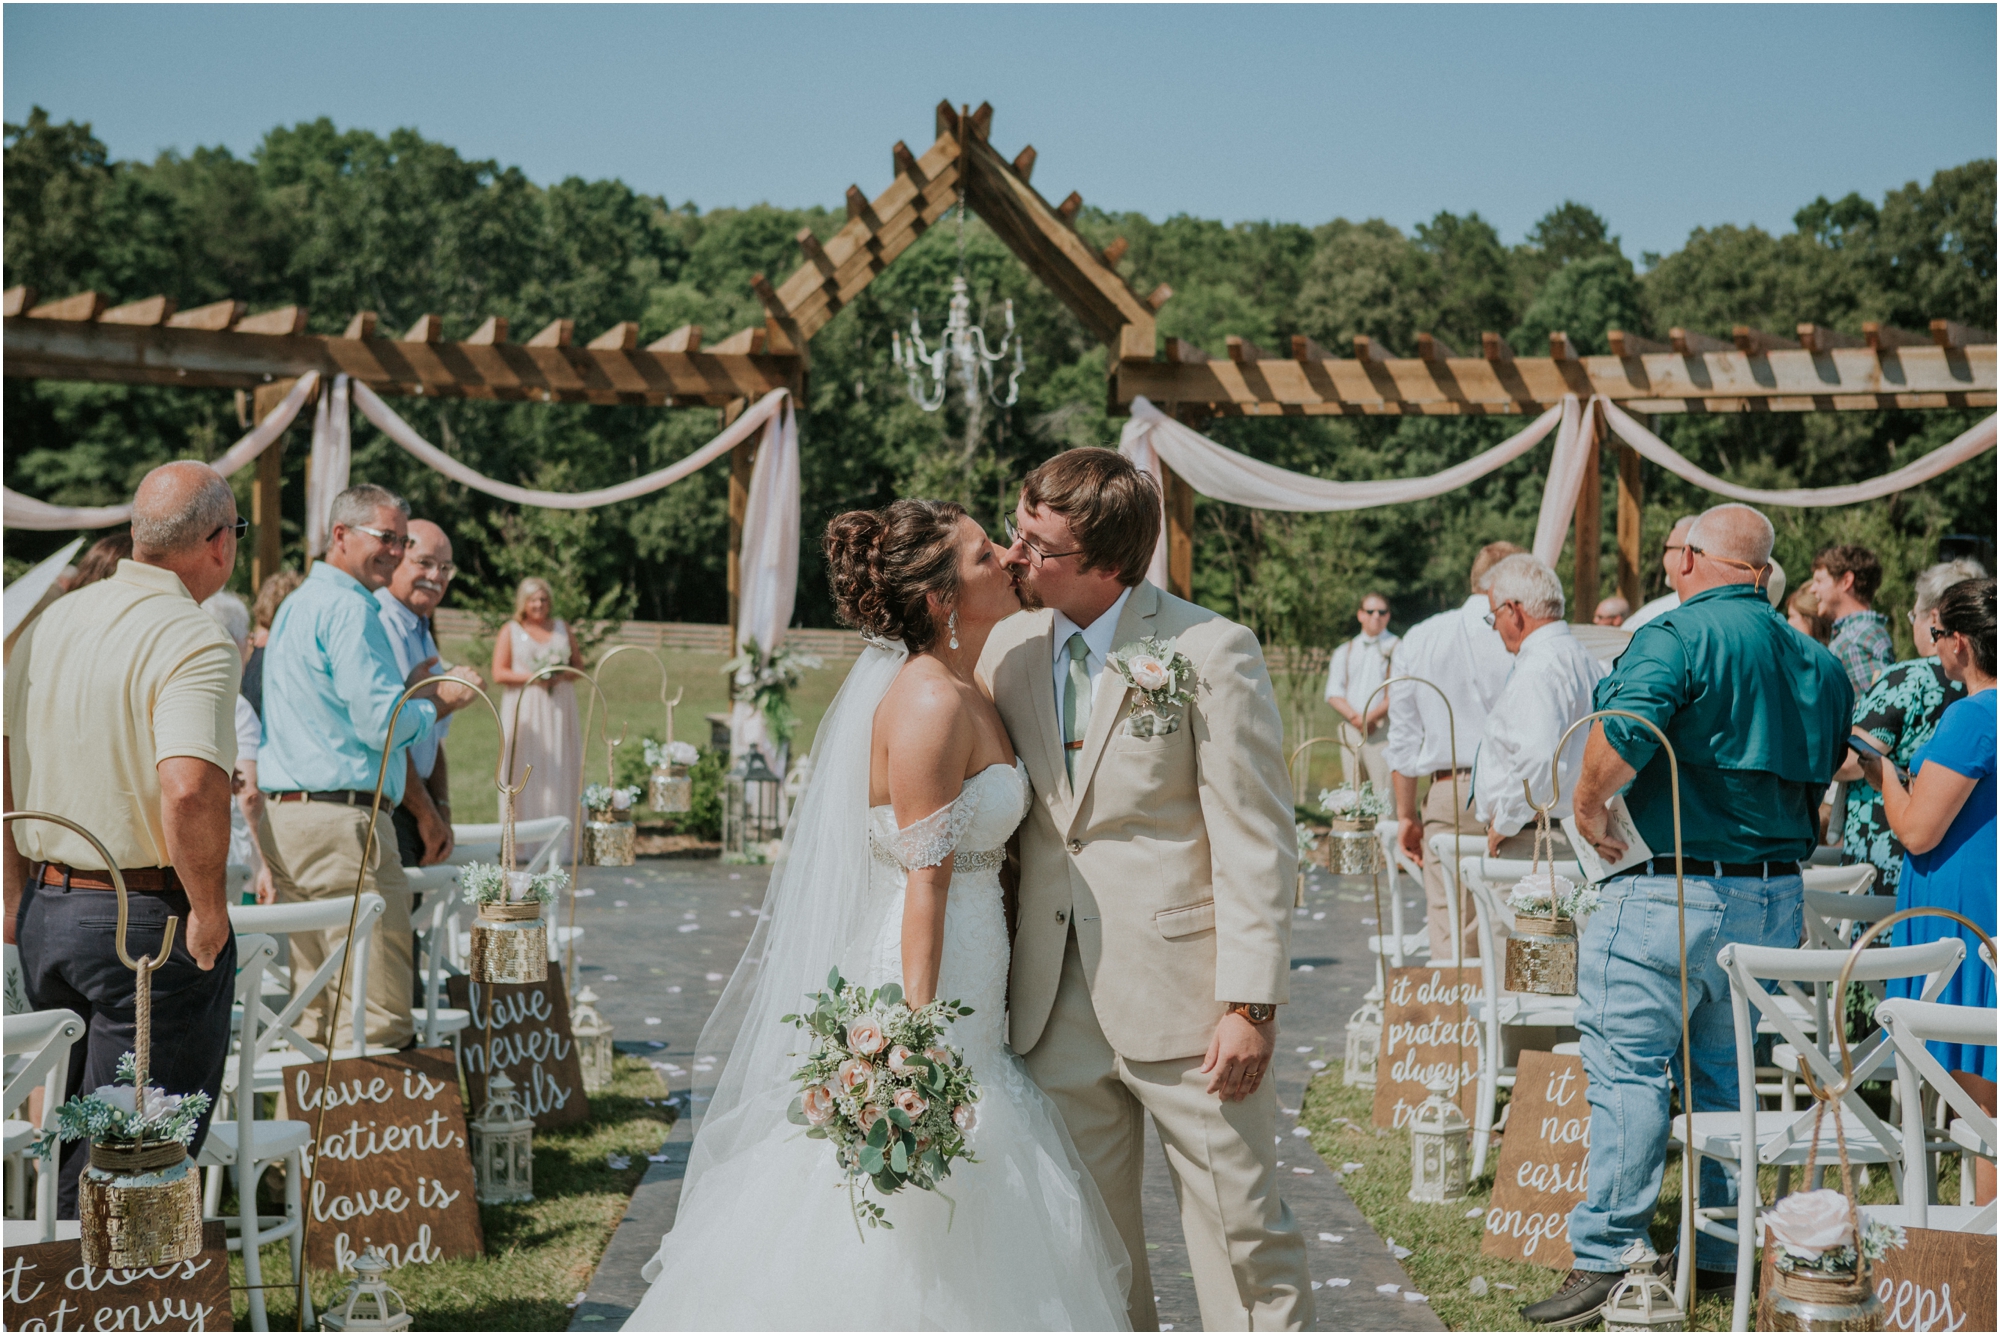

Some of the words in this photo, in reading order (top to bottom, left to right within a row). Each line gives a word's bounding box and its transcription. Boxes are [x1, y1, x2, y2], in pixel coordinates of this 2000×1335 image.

[469, 983, 552, 1030] love
[1390, 976, 1413, 1007] it
[464, 1027, 571, 1074] never
[296, 1070, 394, 1111] love
[403, 1068, 446, 1101] is
[1545, 1067, 1576, 1107] it
[1517, 1150, 1589, 1194] easil
[312, 1180, 410, 1222] love
[418, 1177, 460, 1209] is
[334, 1224, 441, 1274] knd
[3, 1256, 45, 1304] t
[93, 1297, 214, 1332] envy
[1876, 1277, 1967, 1332] eeps
